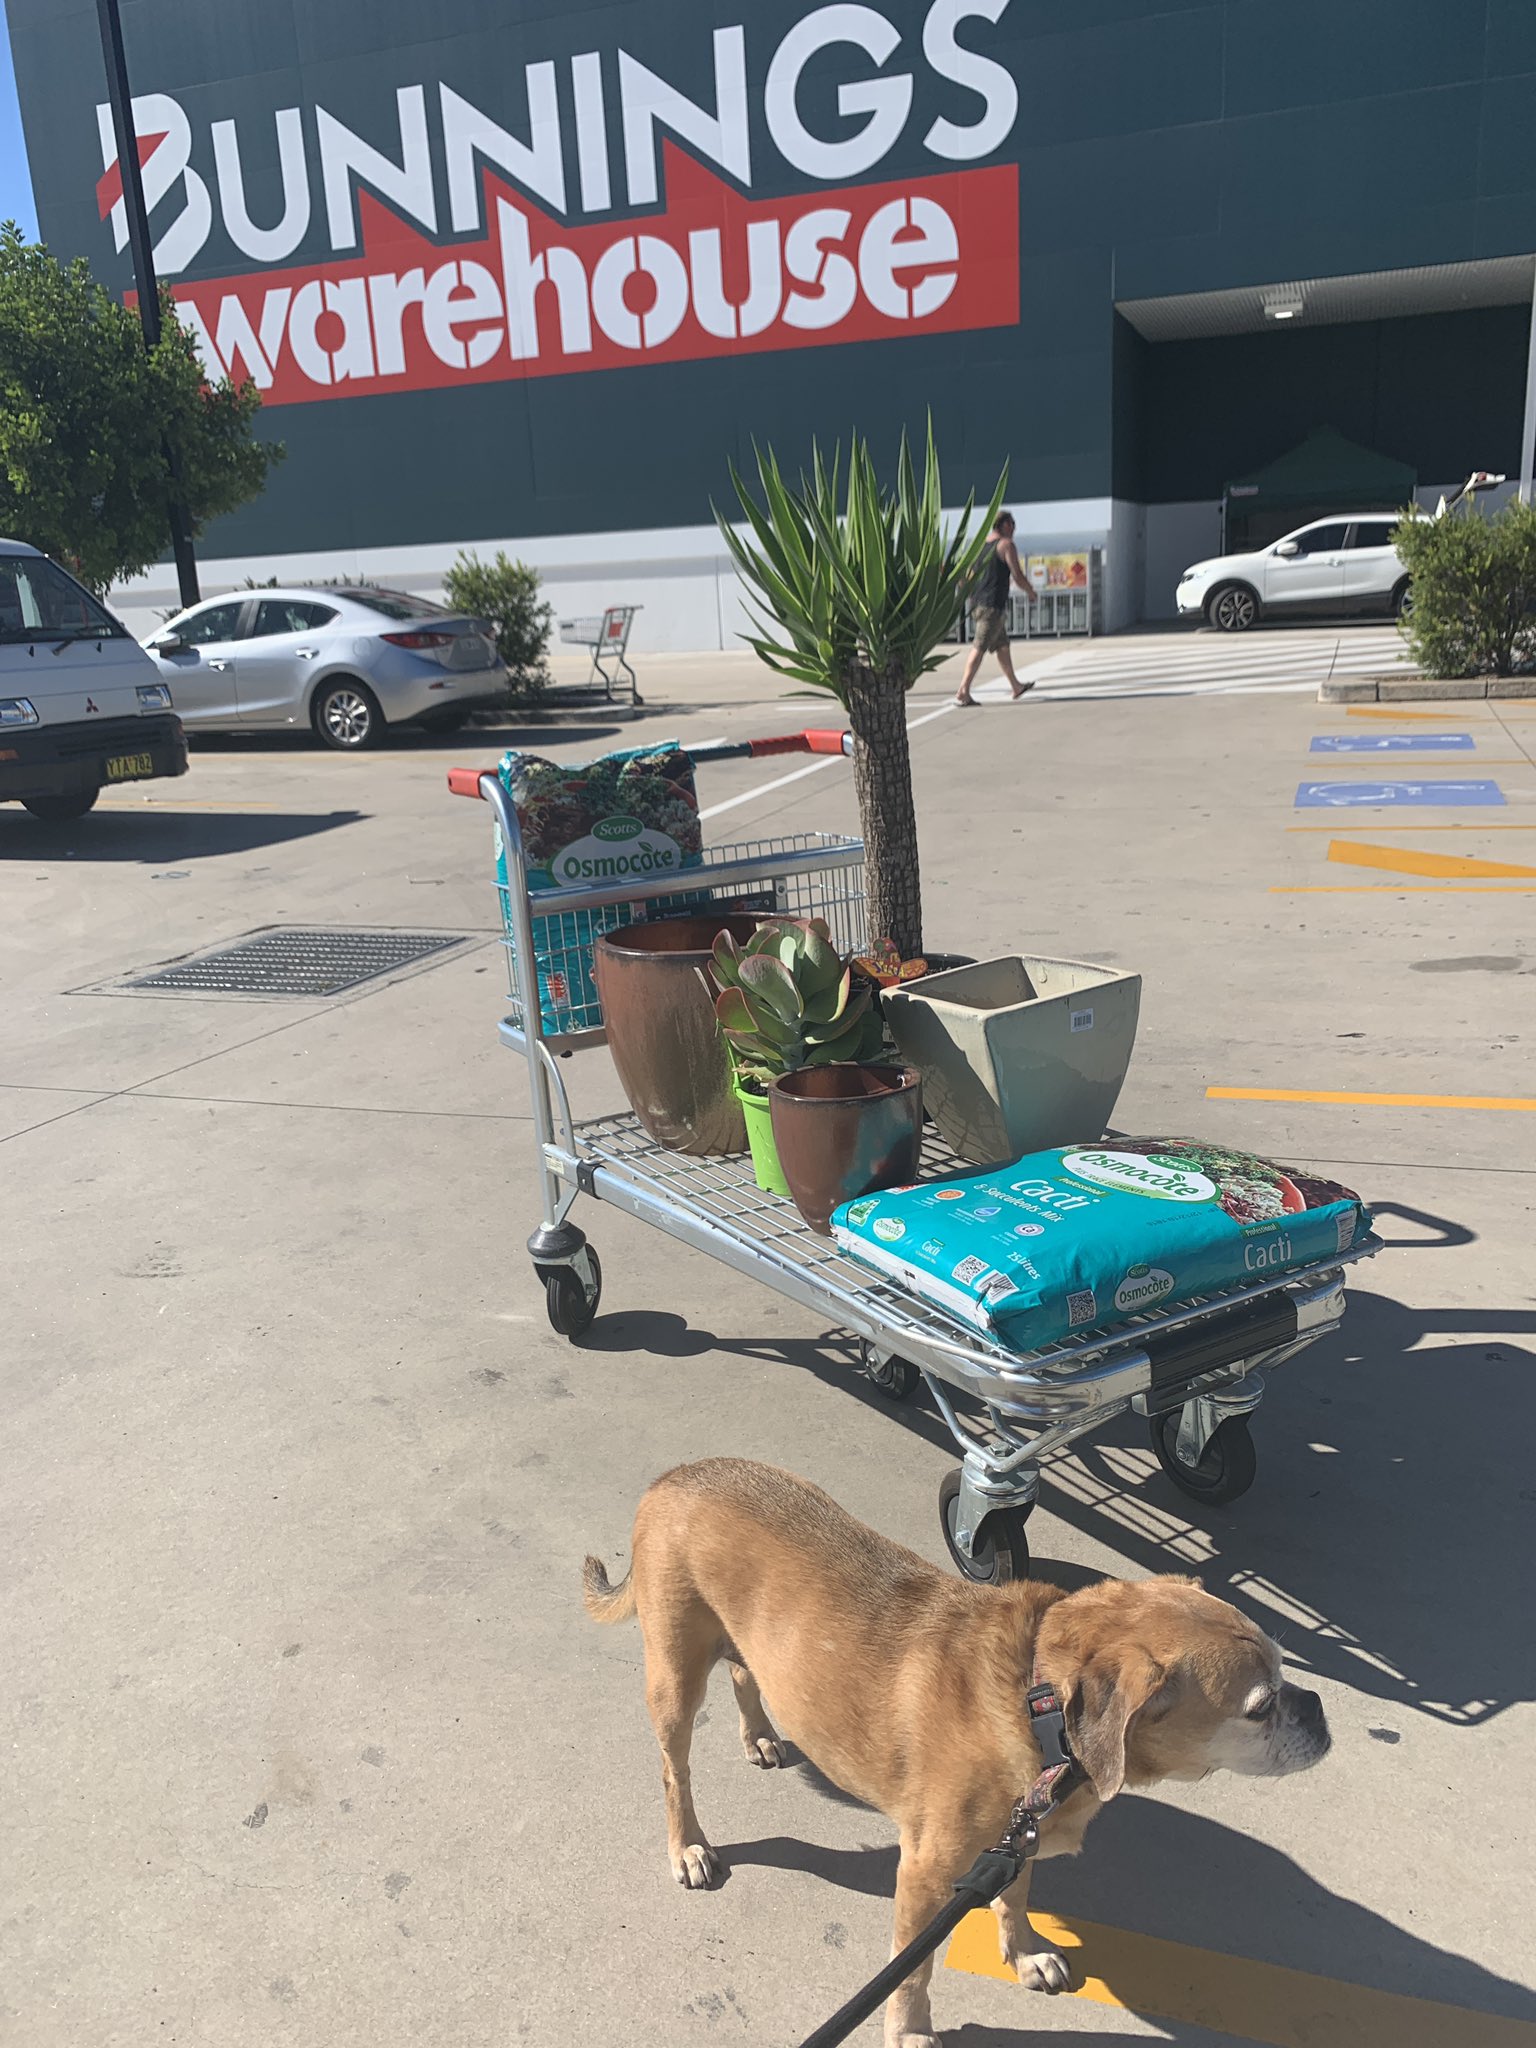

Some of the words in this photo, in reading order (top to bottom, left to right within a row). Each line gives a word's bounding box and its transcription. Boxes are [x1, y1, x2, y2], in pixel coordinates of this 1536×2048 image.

[96, 0, 1019, 276] BUNNINGS
[175, 197, 960, 392] warehouse
[600, 823, 637, 836] Scotts
[563, 849, 674, 879] Osmocote
[1079, 1153, 1200, 1196] Osmocote
[1153, 1155, 1195, 1172] Scotts
[982, 1187, 1042, 1213] Succulents
[1037, 1208, 1065, 1223] Mix
[1010, 1179, 1101, 1211] Cacti
[1245, 1223, 1277, 1237] Professional
[1244, 1232, 1292, 1271] Cacti
[1119, 1278, 1170, 1304] Osmocote
